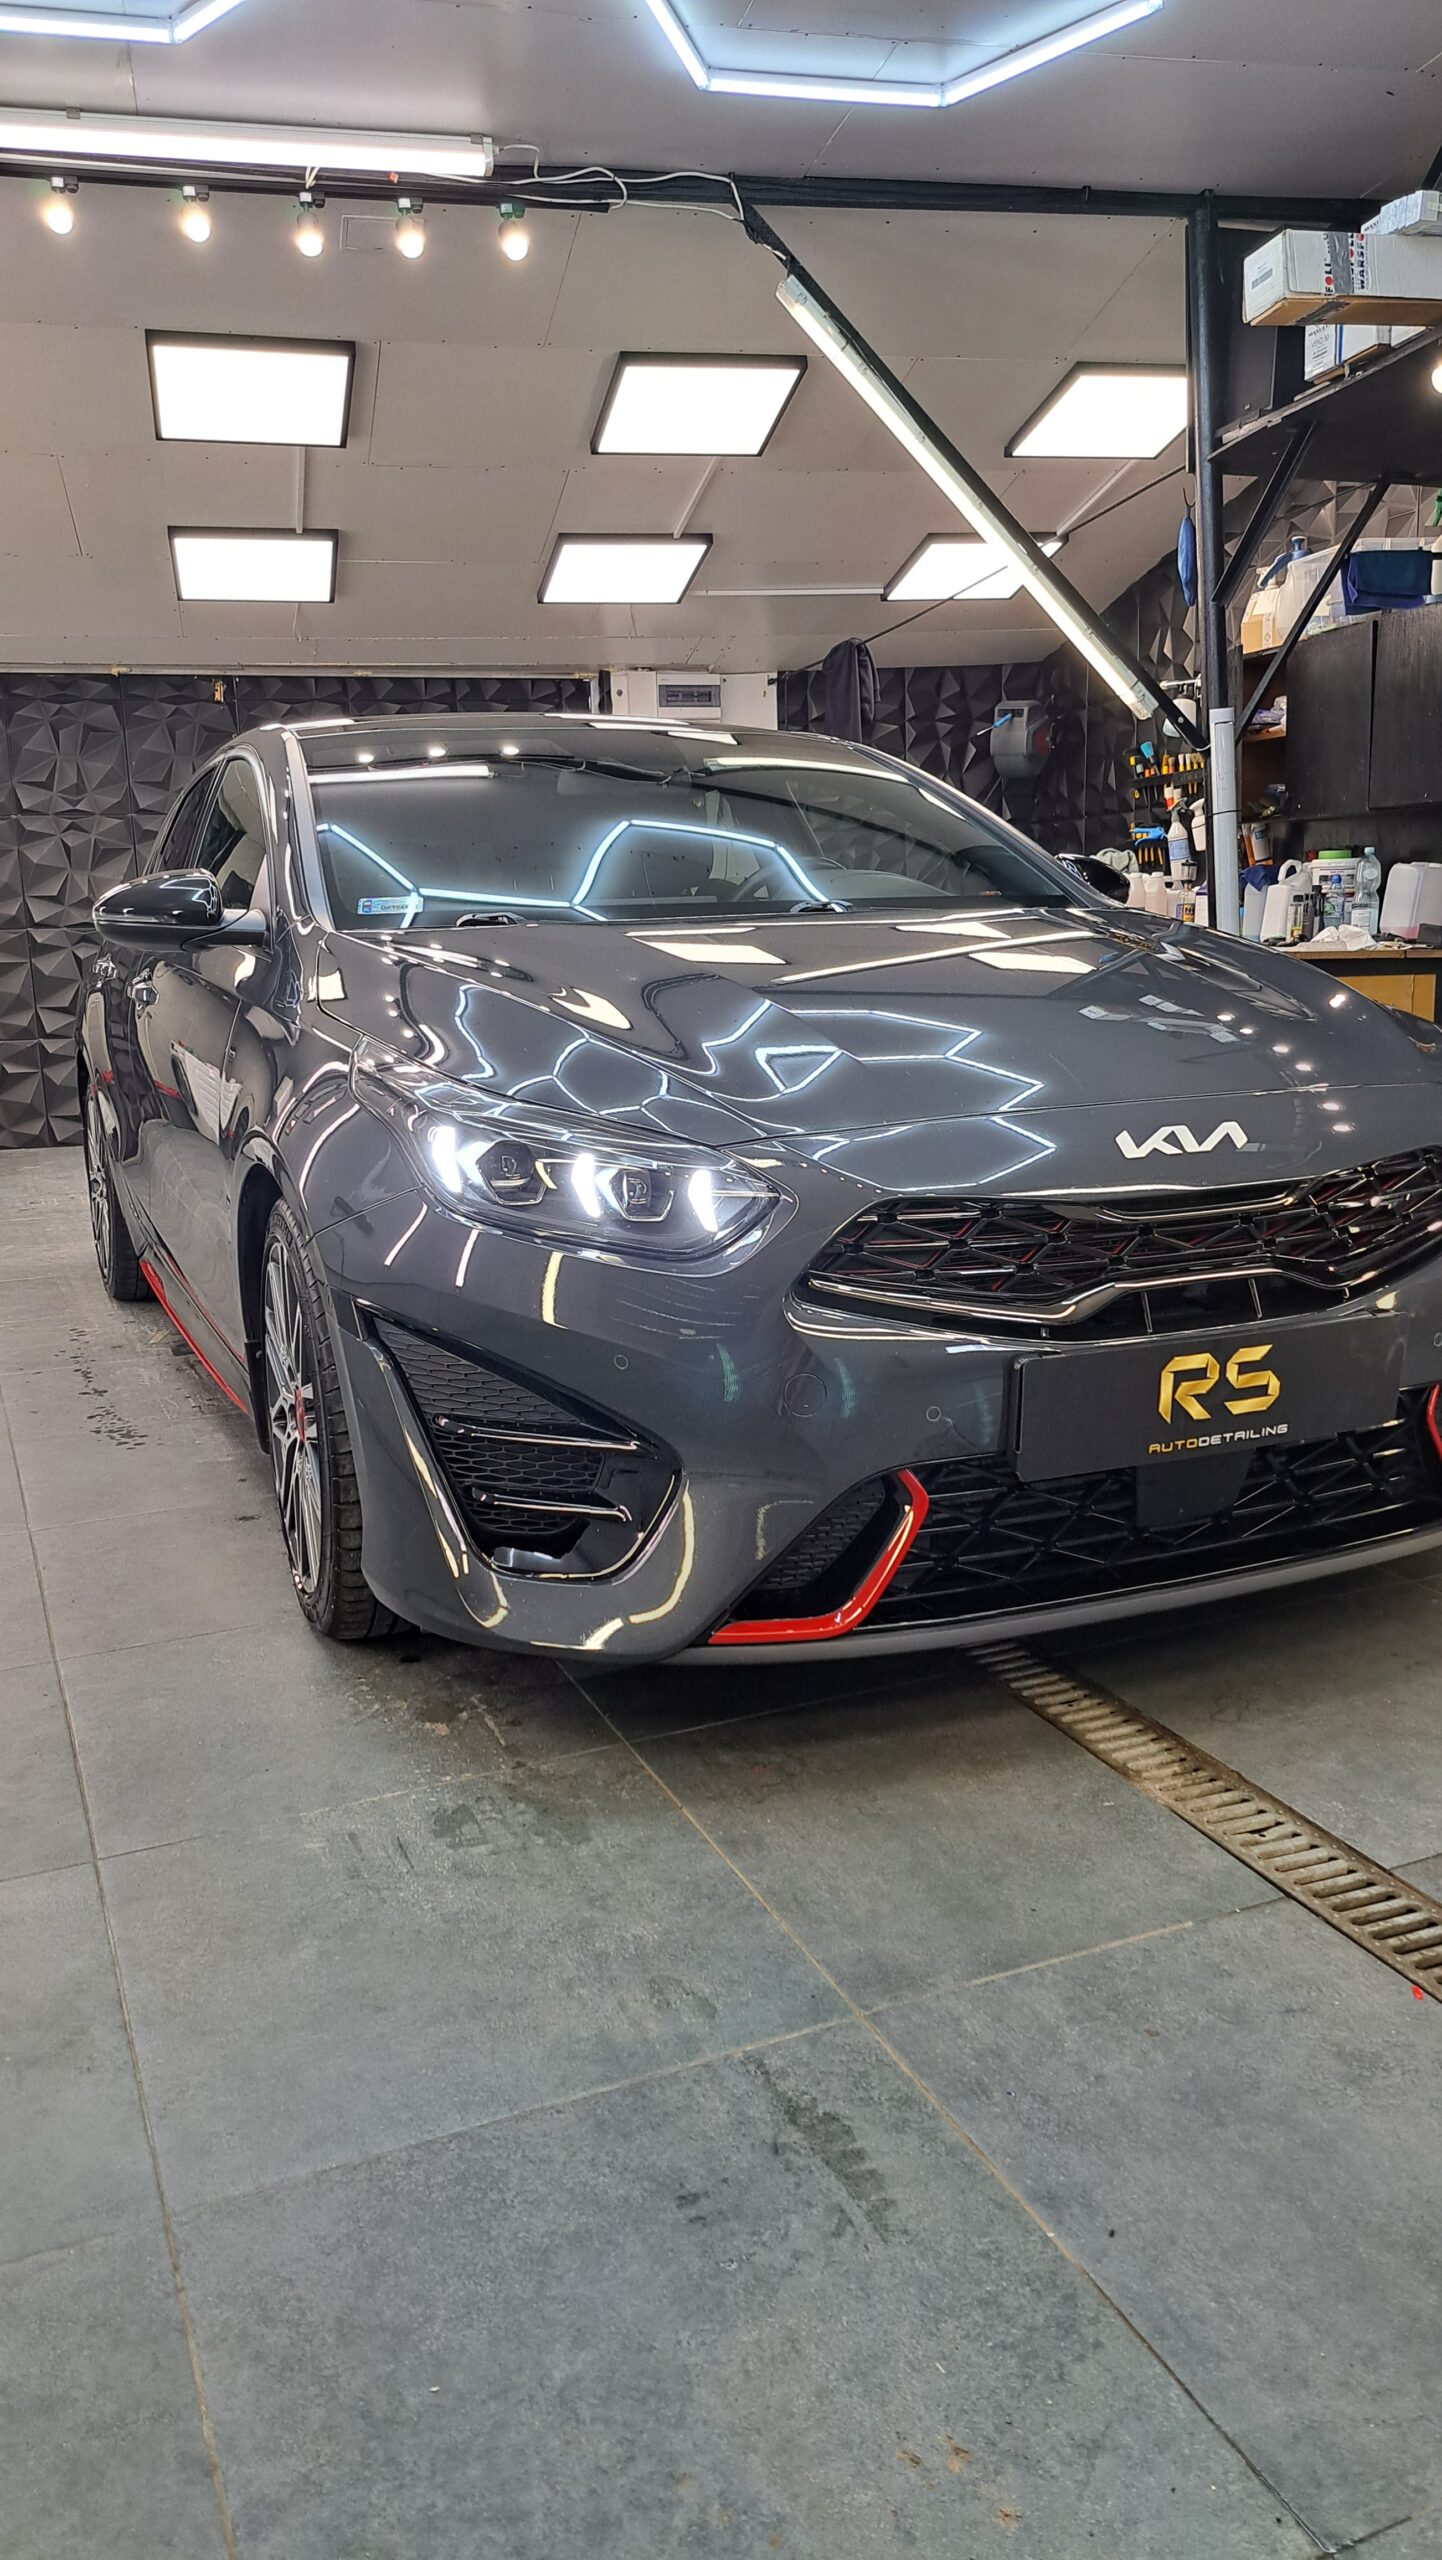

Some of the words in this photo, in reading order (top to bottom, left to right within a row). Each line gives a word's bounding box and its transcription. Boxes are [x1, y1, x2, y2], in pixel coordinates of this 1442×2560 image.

[1115, 1121, 1248, 1159] KIA
[1158, 1344, 1281, 1424] RS
[1148, 1424, 1289, 1454] AUTODETAILING
